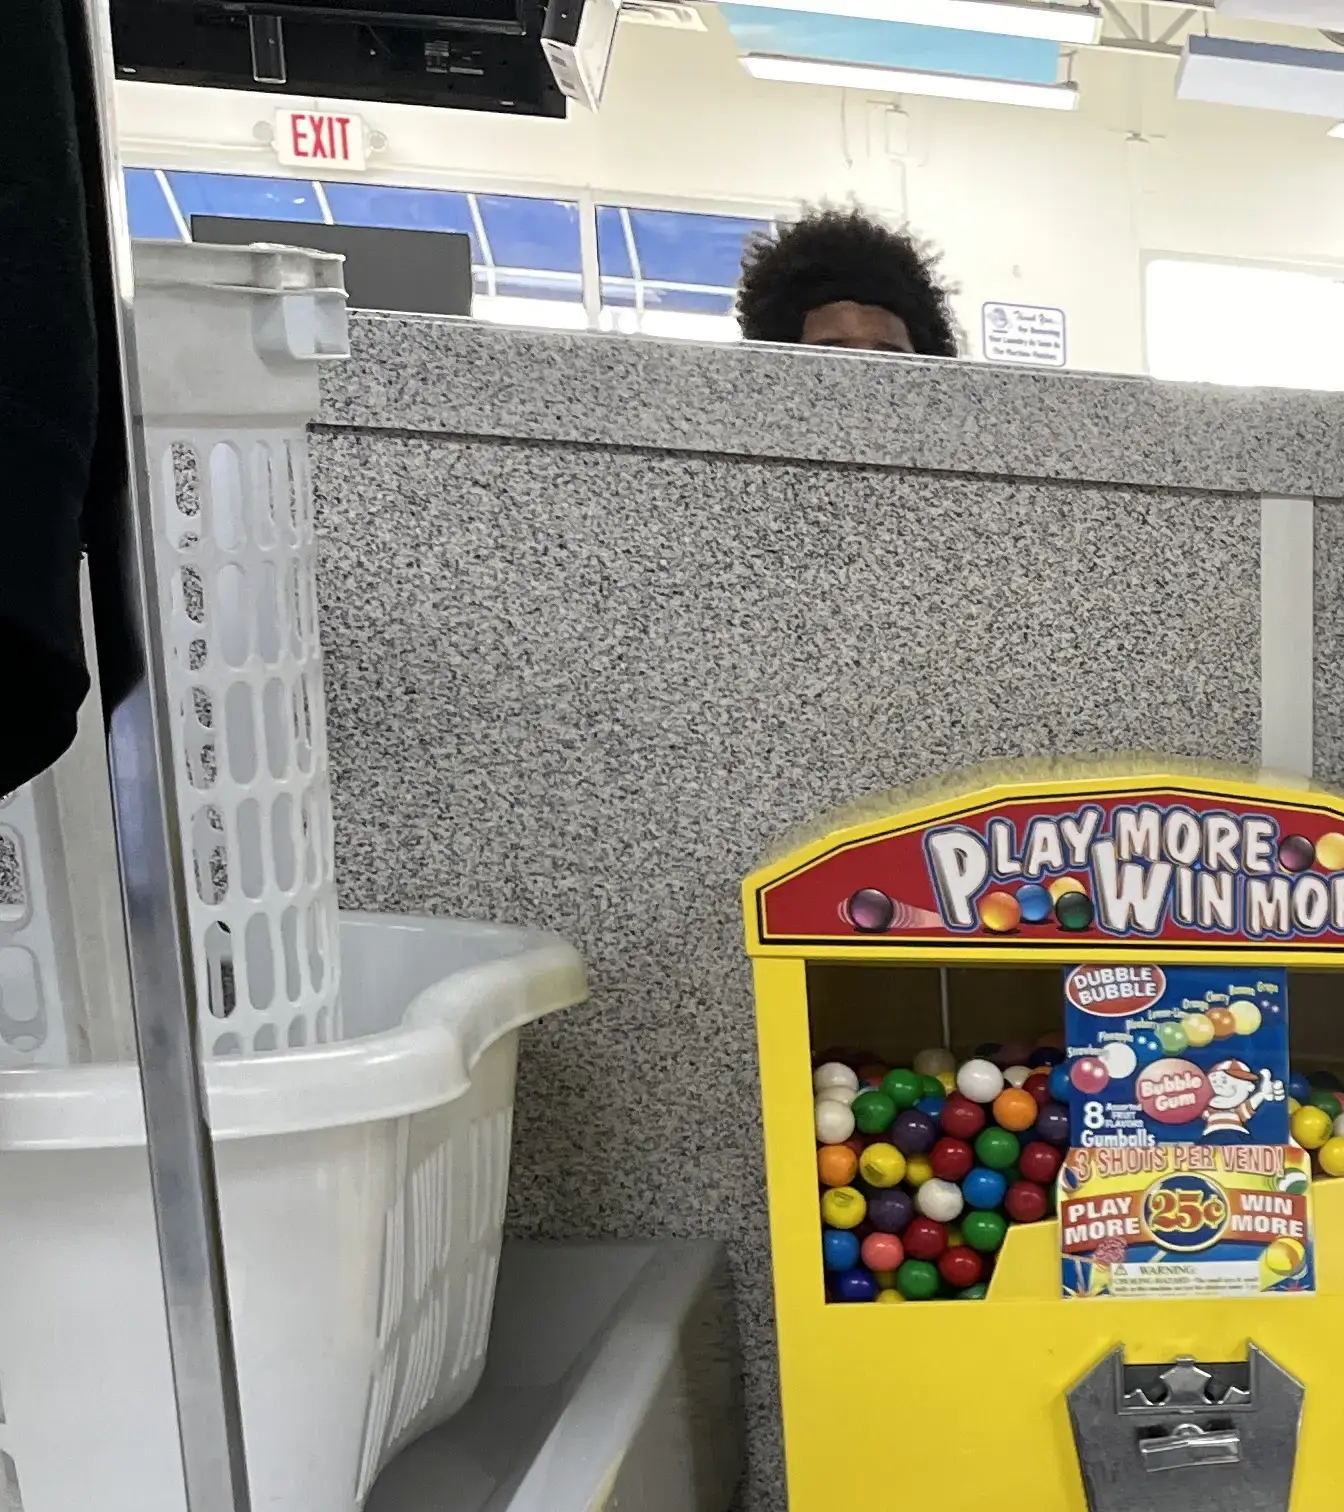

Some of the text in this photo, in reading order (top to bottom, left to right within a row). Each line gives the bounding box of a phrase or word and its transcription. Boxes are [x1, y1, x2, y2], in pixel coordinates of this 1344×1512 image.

[291, 114, 350, 160] EXIT
[928, 807, 1275, 926] PLAY MORE
[1092, 839, 1236, 933] WIN
[1074, 966, 1153, 990] DUBBLE
[1079, 983, 1157, 1005] BUBBLE
[1141, 1071, 1202, 1098] Bubble
[1083, 1101, 1105, 1129] 8
[1155, 1093, 1196, 1111] Gum
[1081, 1129, 1156, 1148] Gumballs
[1076, 1146, 1286, 1182] 3 SHOTS PER VEND!
[1068, 1196, 1133, 1223] PLAY
[1150, 1187, 1227, 1234] 25¢
[1240, 1193, 1293, 1216] WIN
[1065, 1218, 1140, 1245] MORE
[1231, 1214, 1305, 1238] MORE
